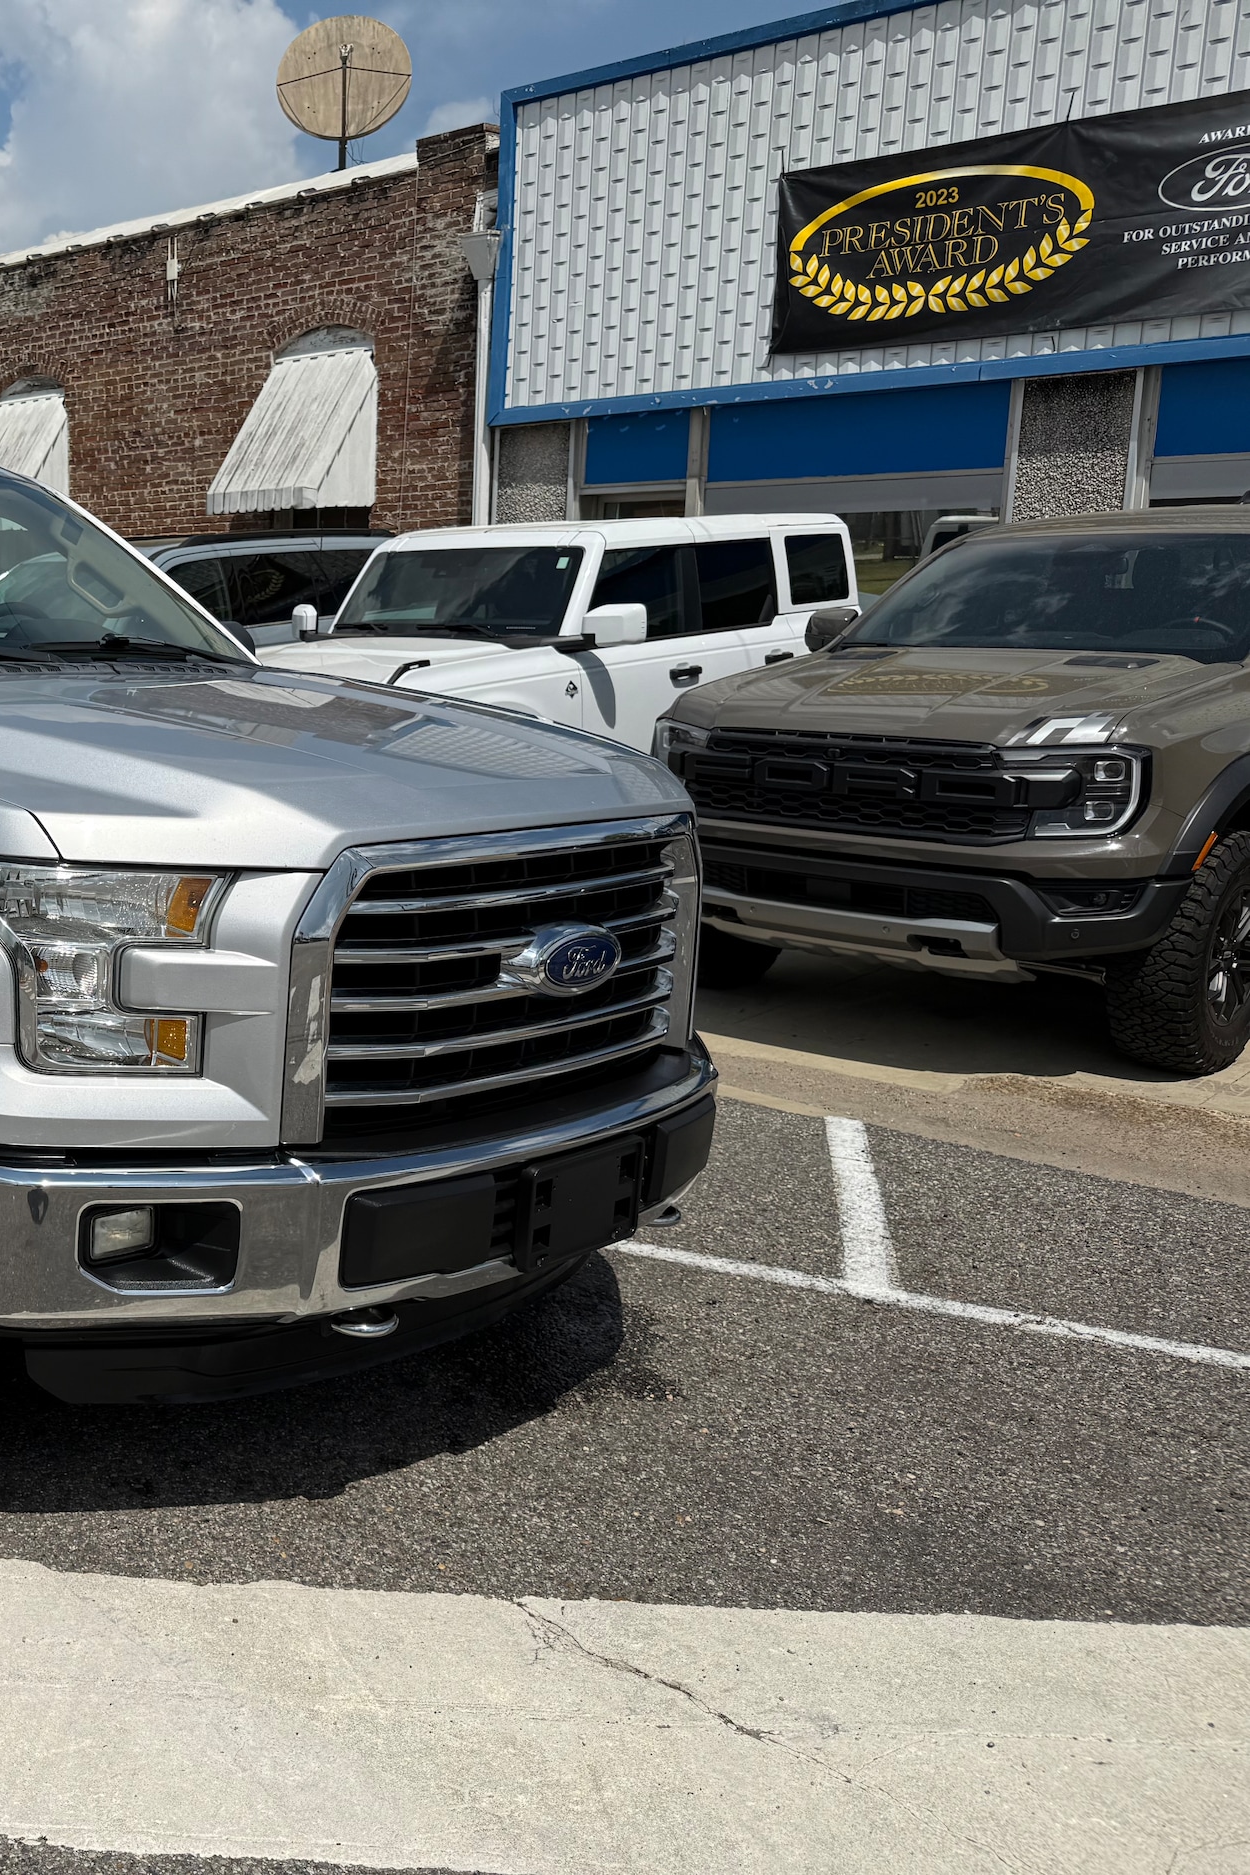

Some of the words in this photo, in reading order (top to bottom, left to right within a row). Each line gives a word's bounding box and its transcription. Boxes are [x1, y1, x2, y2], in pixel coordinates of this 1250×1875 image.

[1191, 153, 1250, 202] Fo
[915, 187, 960, 209] 2023
[819, 193, 1066, 257] PRESIDENT'S
[1122, 228, 1155, 244] FOR
[1161, 234, 1230, 256] SERVICE
[866, 235, 999, 279] AWARD
[684, 752, 1019, 807] FORD
[562, 945, 607, 981] Ford
